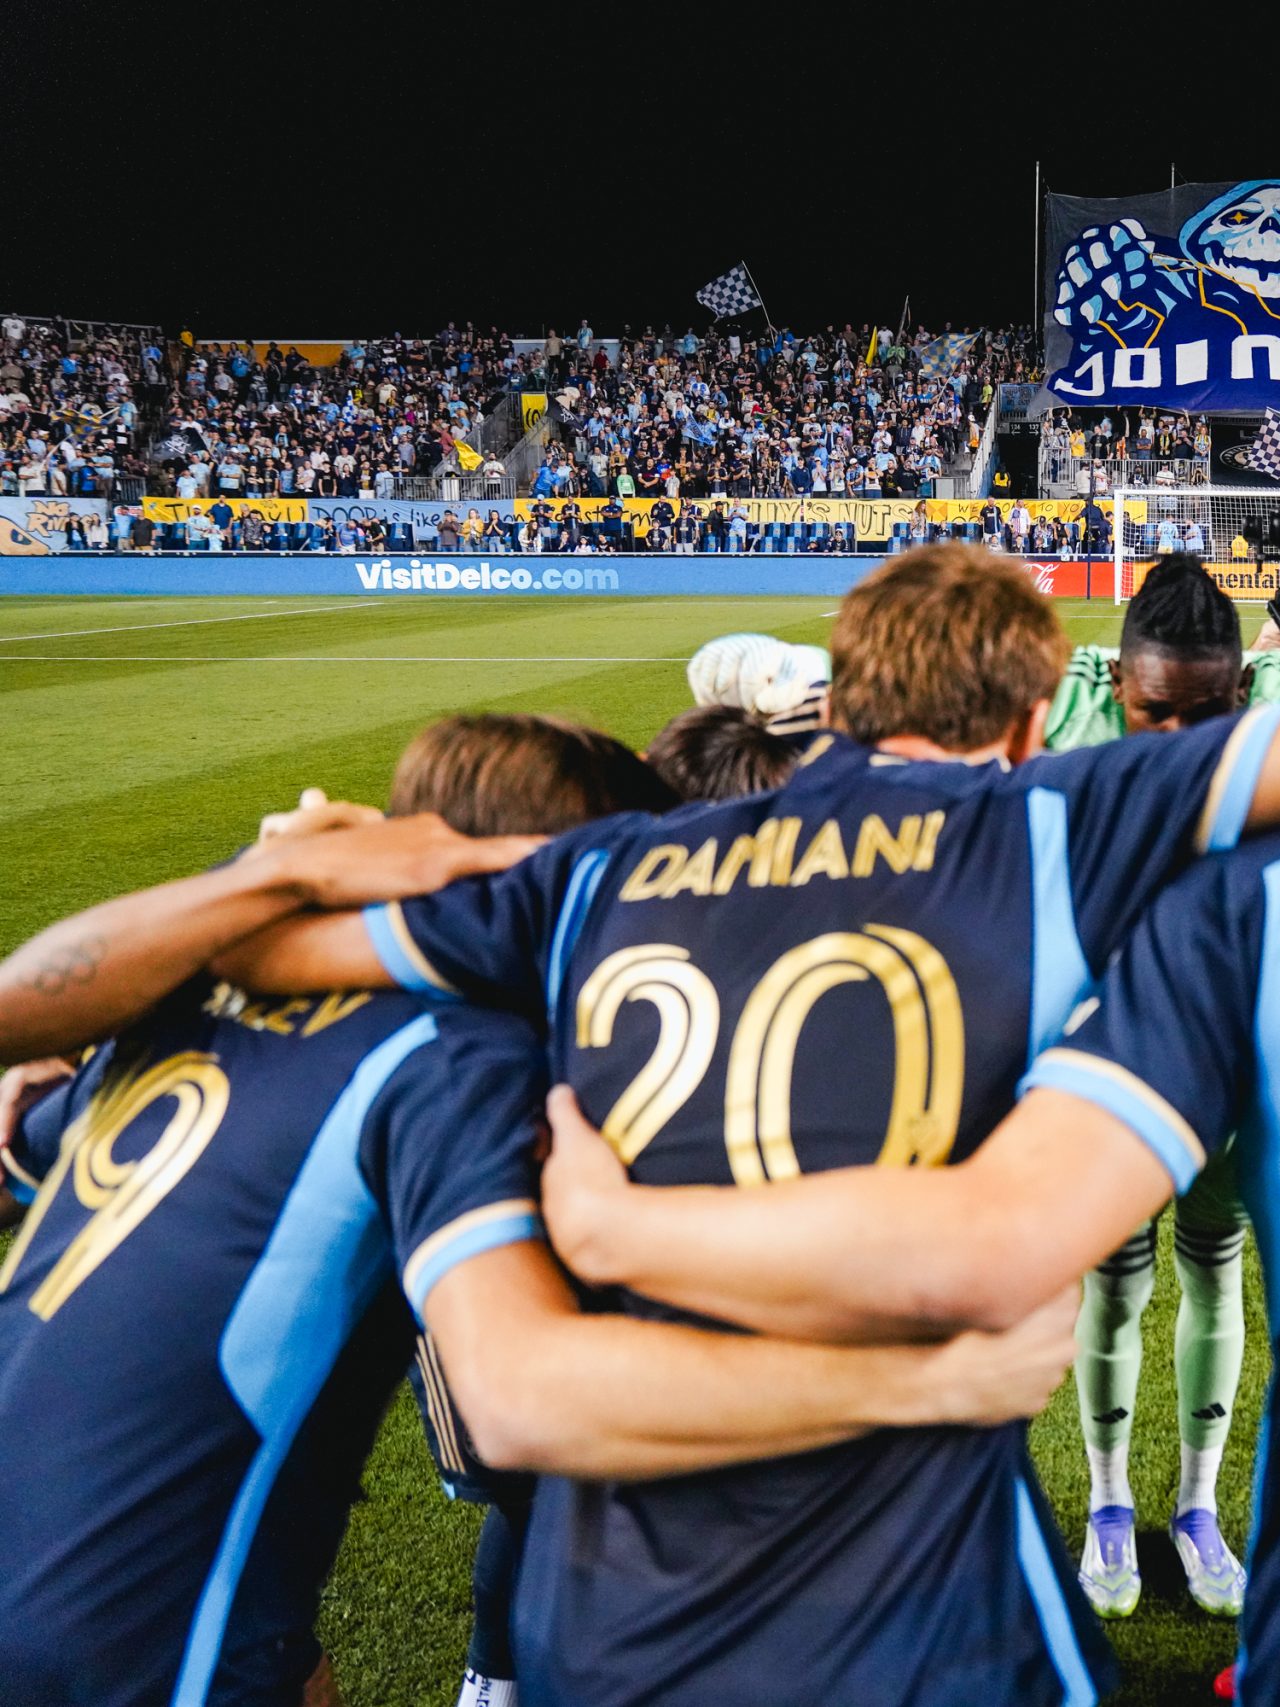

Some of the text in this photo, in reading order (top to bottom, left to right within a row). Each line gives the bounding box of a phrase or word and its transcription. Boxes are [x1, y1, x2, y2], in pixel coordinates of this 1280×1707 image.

[355, 559, 619, 590] VisitDelco.com
[618, 809, 946, 903] DAMIANI
[575, 921, 966, 1189] 20
